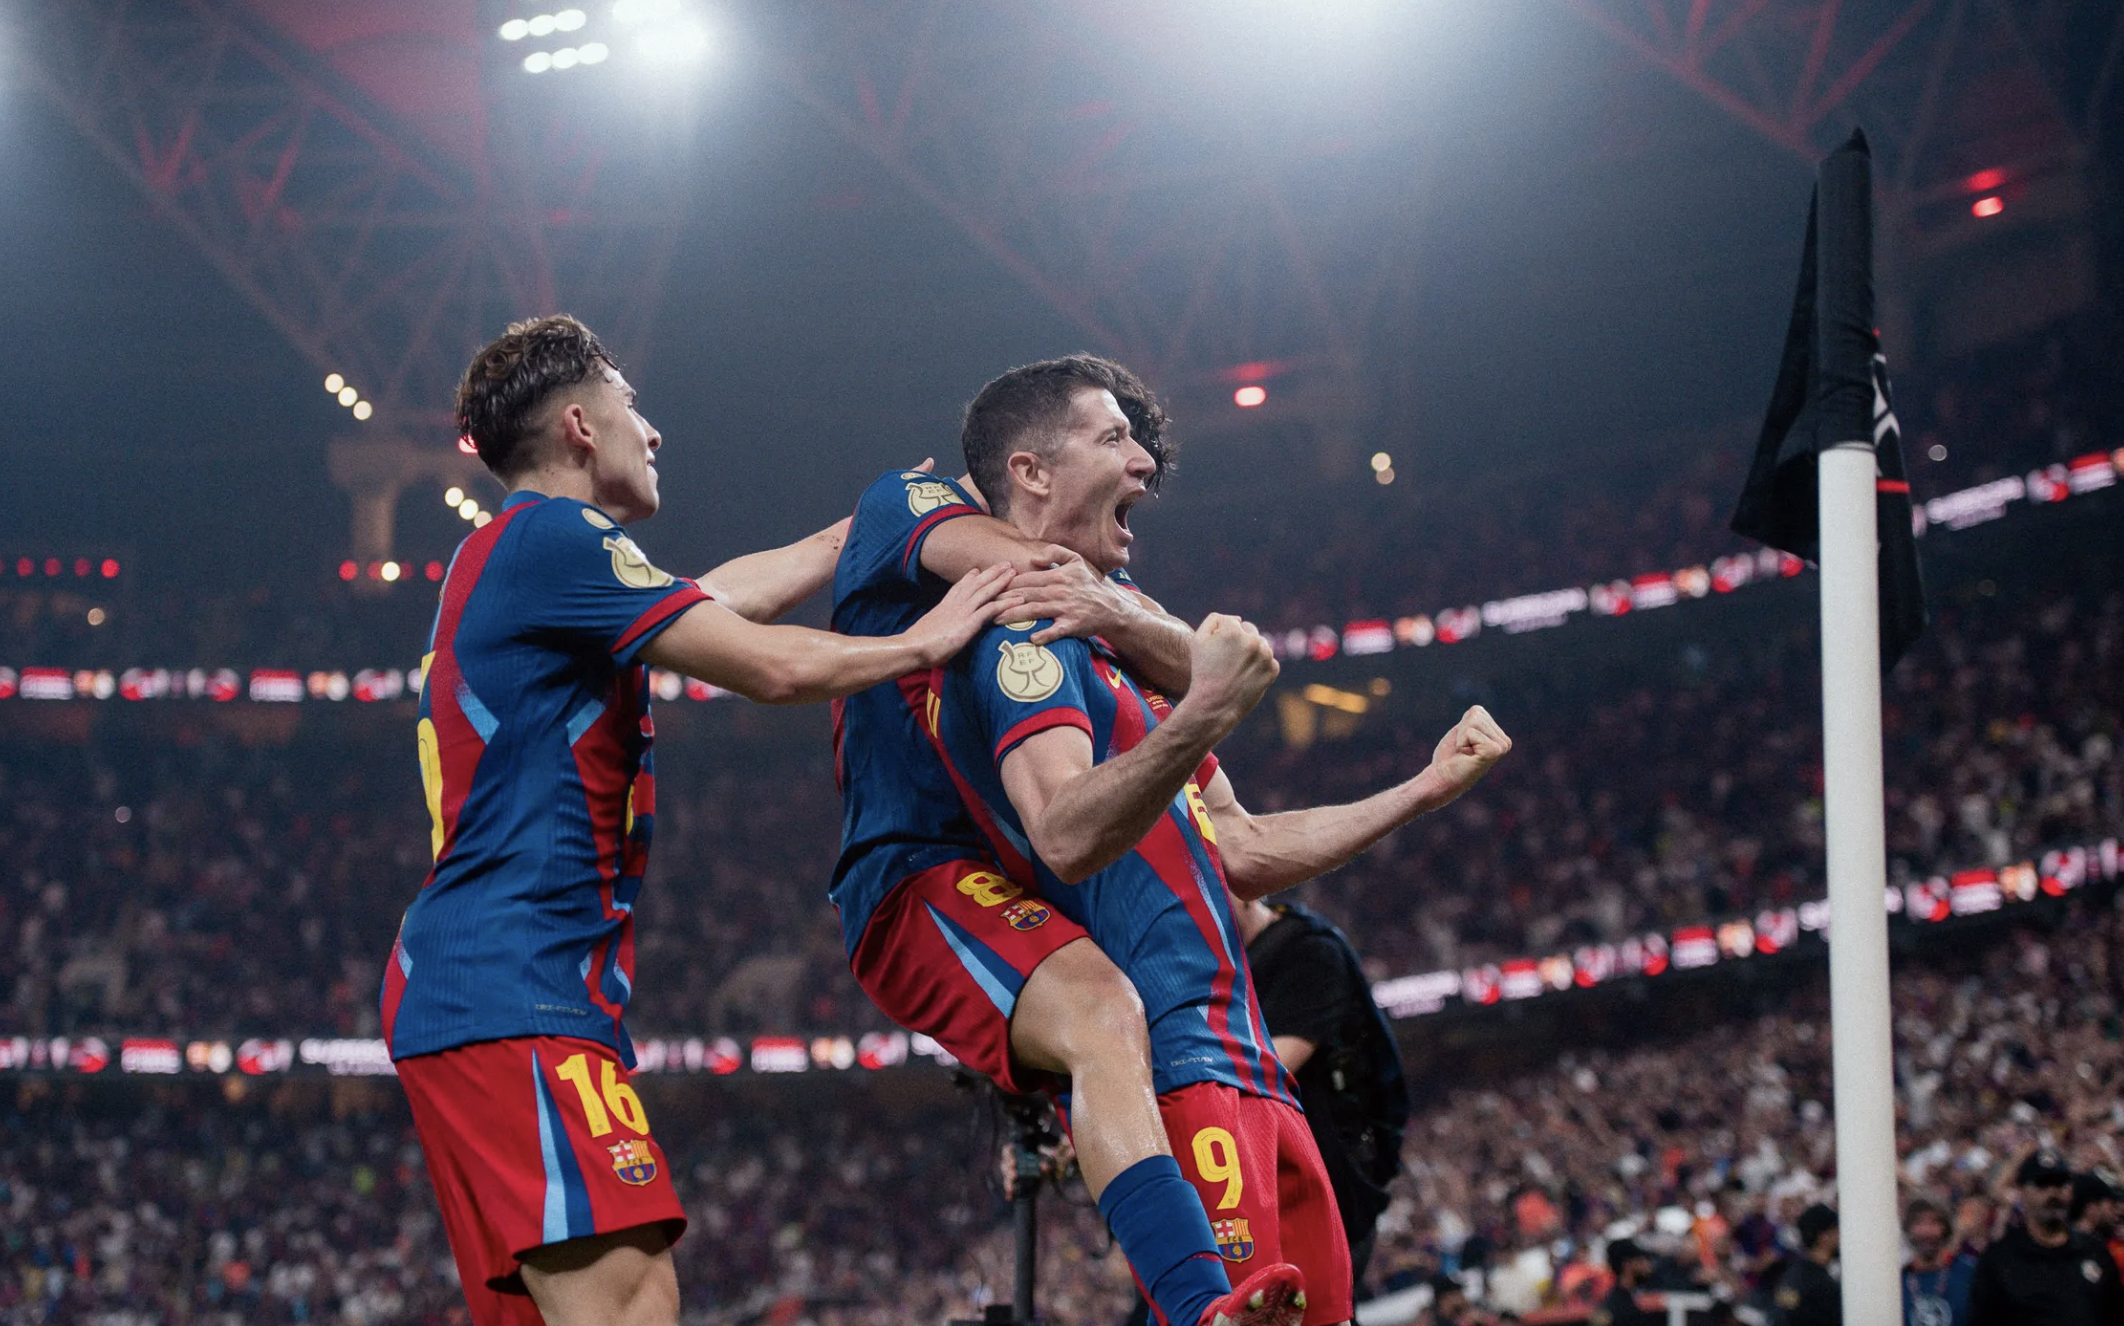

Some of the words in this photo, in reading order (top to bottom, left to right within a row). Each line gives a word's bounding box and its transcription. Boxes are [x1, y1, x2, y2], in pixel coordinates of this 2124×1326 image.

[956, 871, 1023, 907] 8
[555, 1053, 650, 1138] 16
[1191, 1126, 1243, 1210] 9
[1226, 1235, 1243, 1243] FCB
